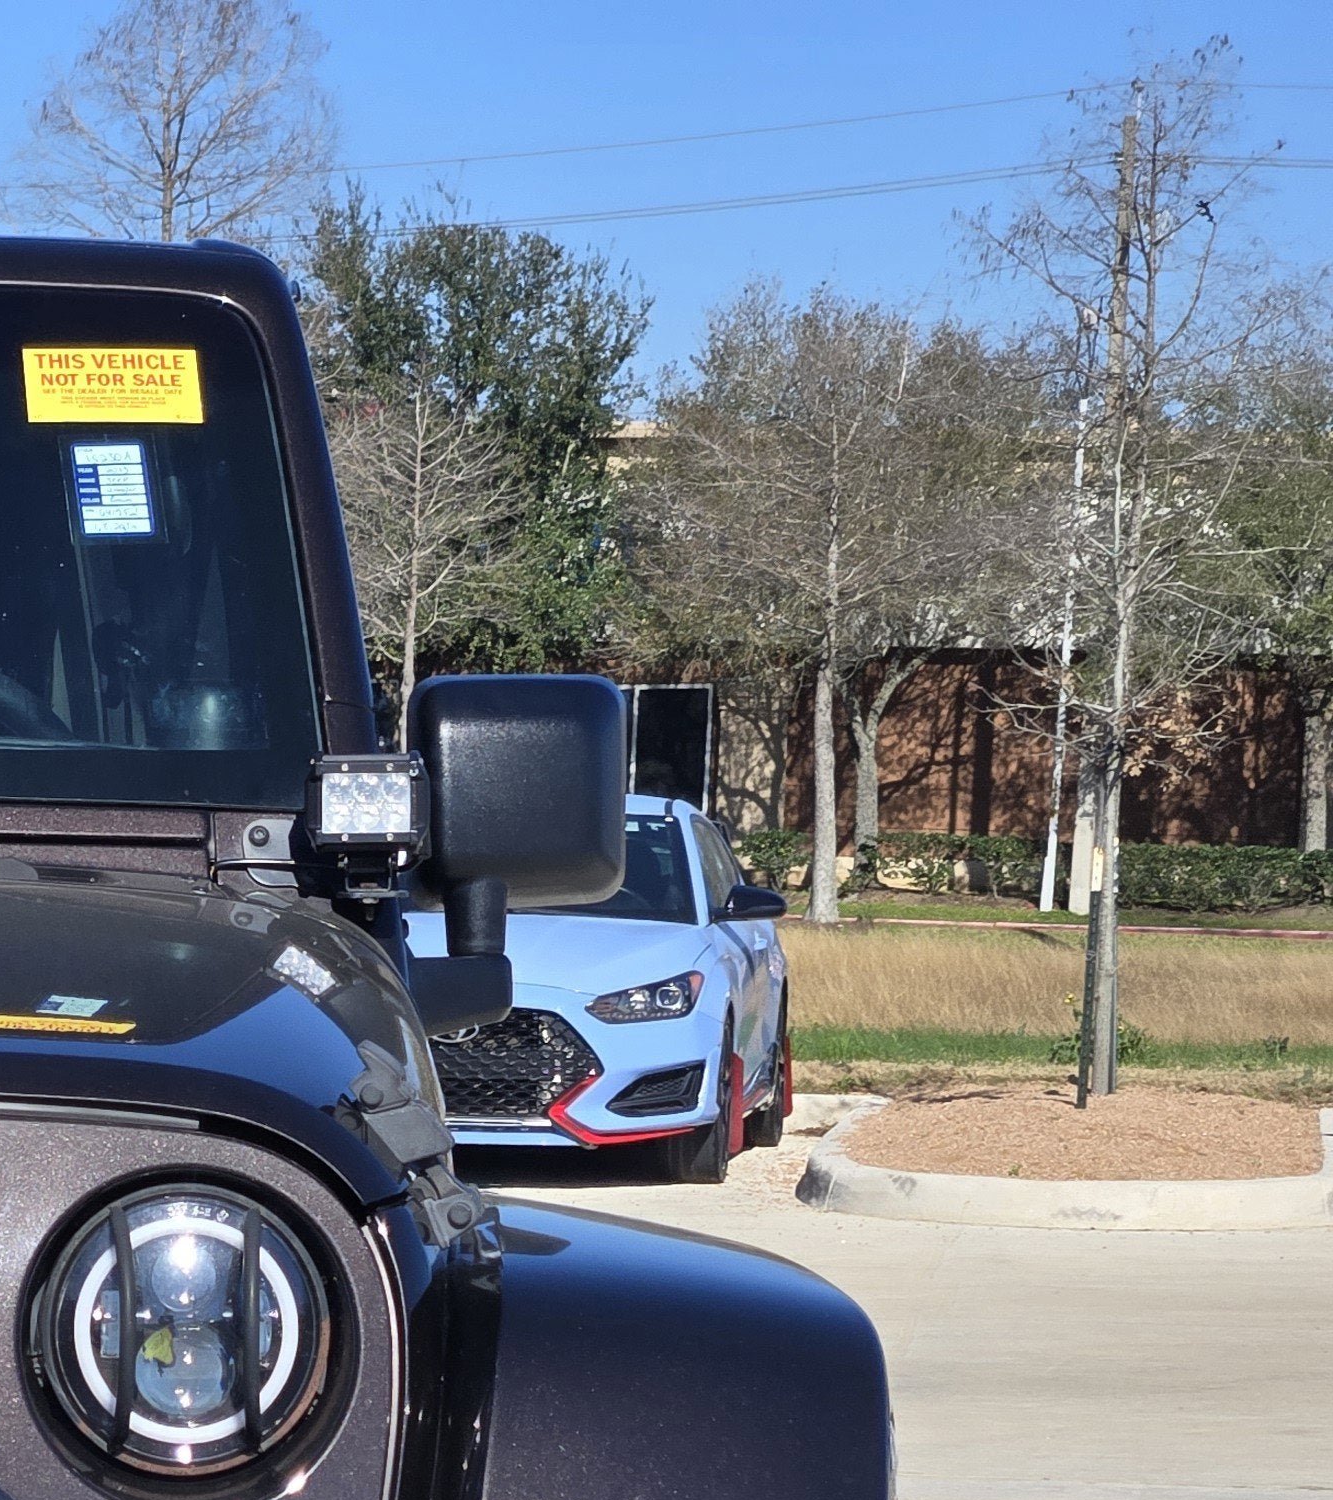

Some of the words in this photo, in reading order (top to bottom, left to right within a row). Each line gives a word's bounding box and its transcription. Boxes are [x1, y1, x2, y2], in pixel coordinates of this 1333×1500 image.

[34, 353, 85, 369] THIS
[91, 353, 186, 370] VEHICLE
[41, 373, 79, 386] NOT
[86, 373, 125, 386] FOR
[133, 374, 183, 387] SALE
